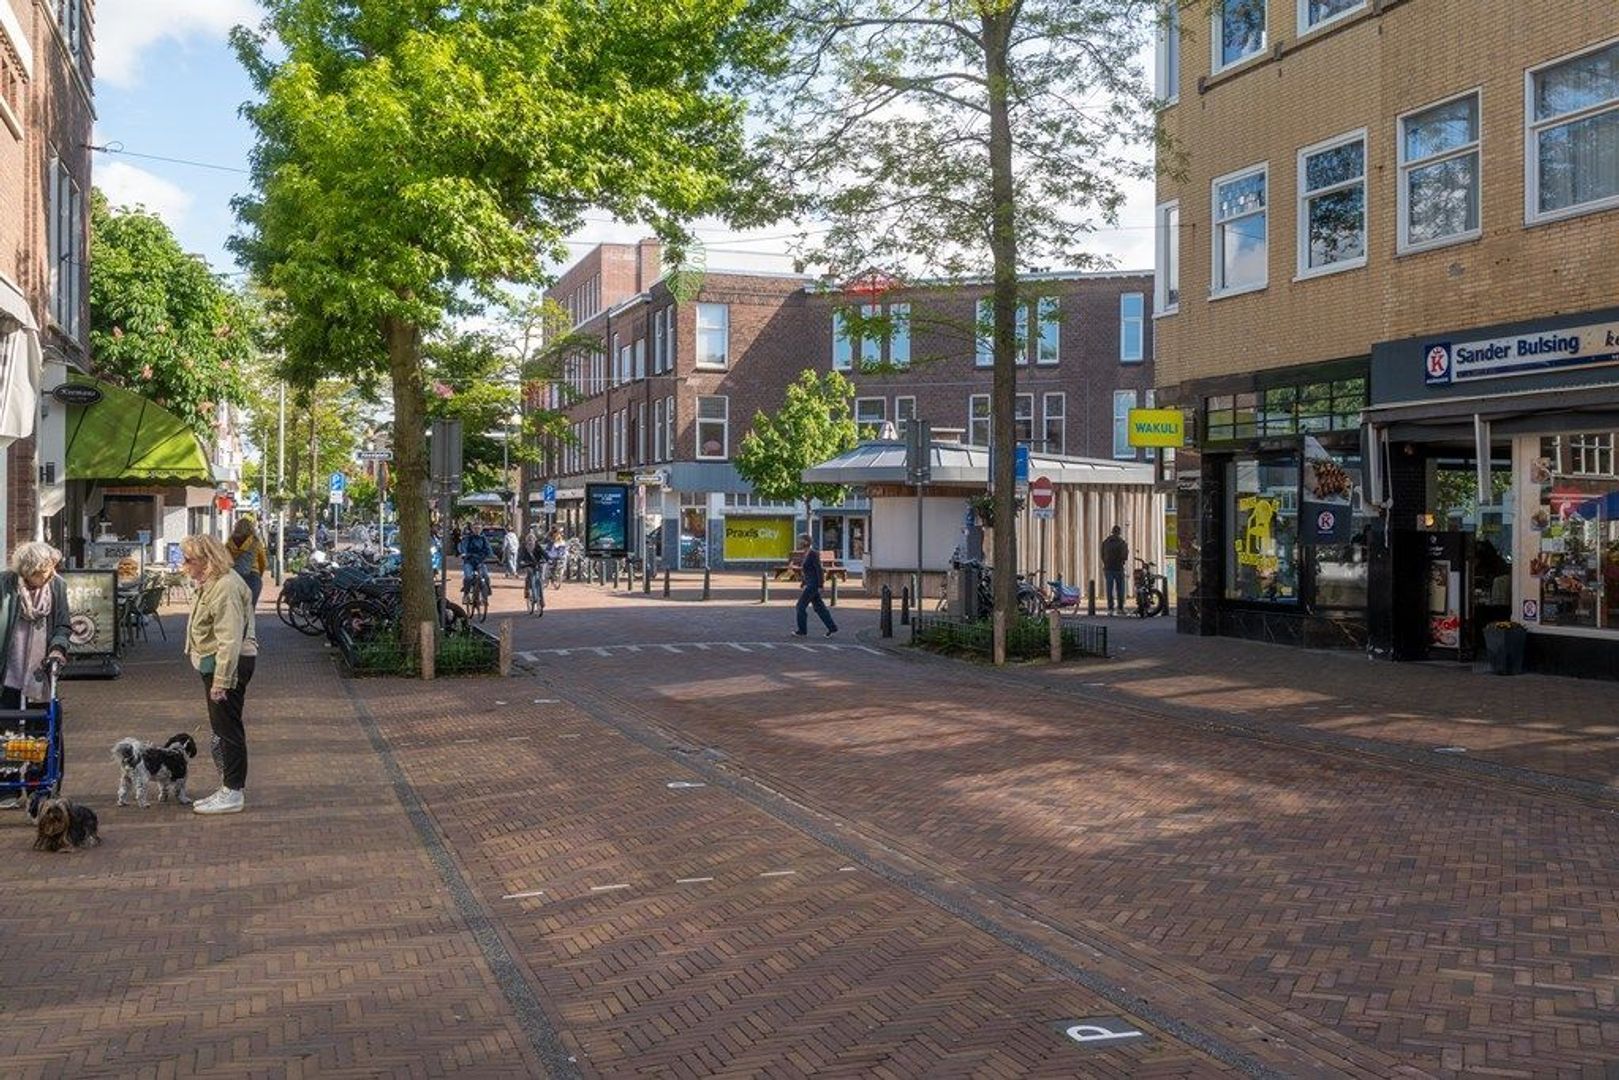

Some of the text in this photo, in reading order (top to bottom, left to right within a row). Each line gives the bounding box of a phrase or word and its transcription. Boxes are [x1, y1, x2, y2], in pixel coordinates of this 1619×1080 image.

[1456, 335, 1580, 365] Sander Bulsing
[1431, 355, 1445, 373] K
[1135, 422, 1178, 433] WAKULI
[1066, 1025, 1143, 1042] P
